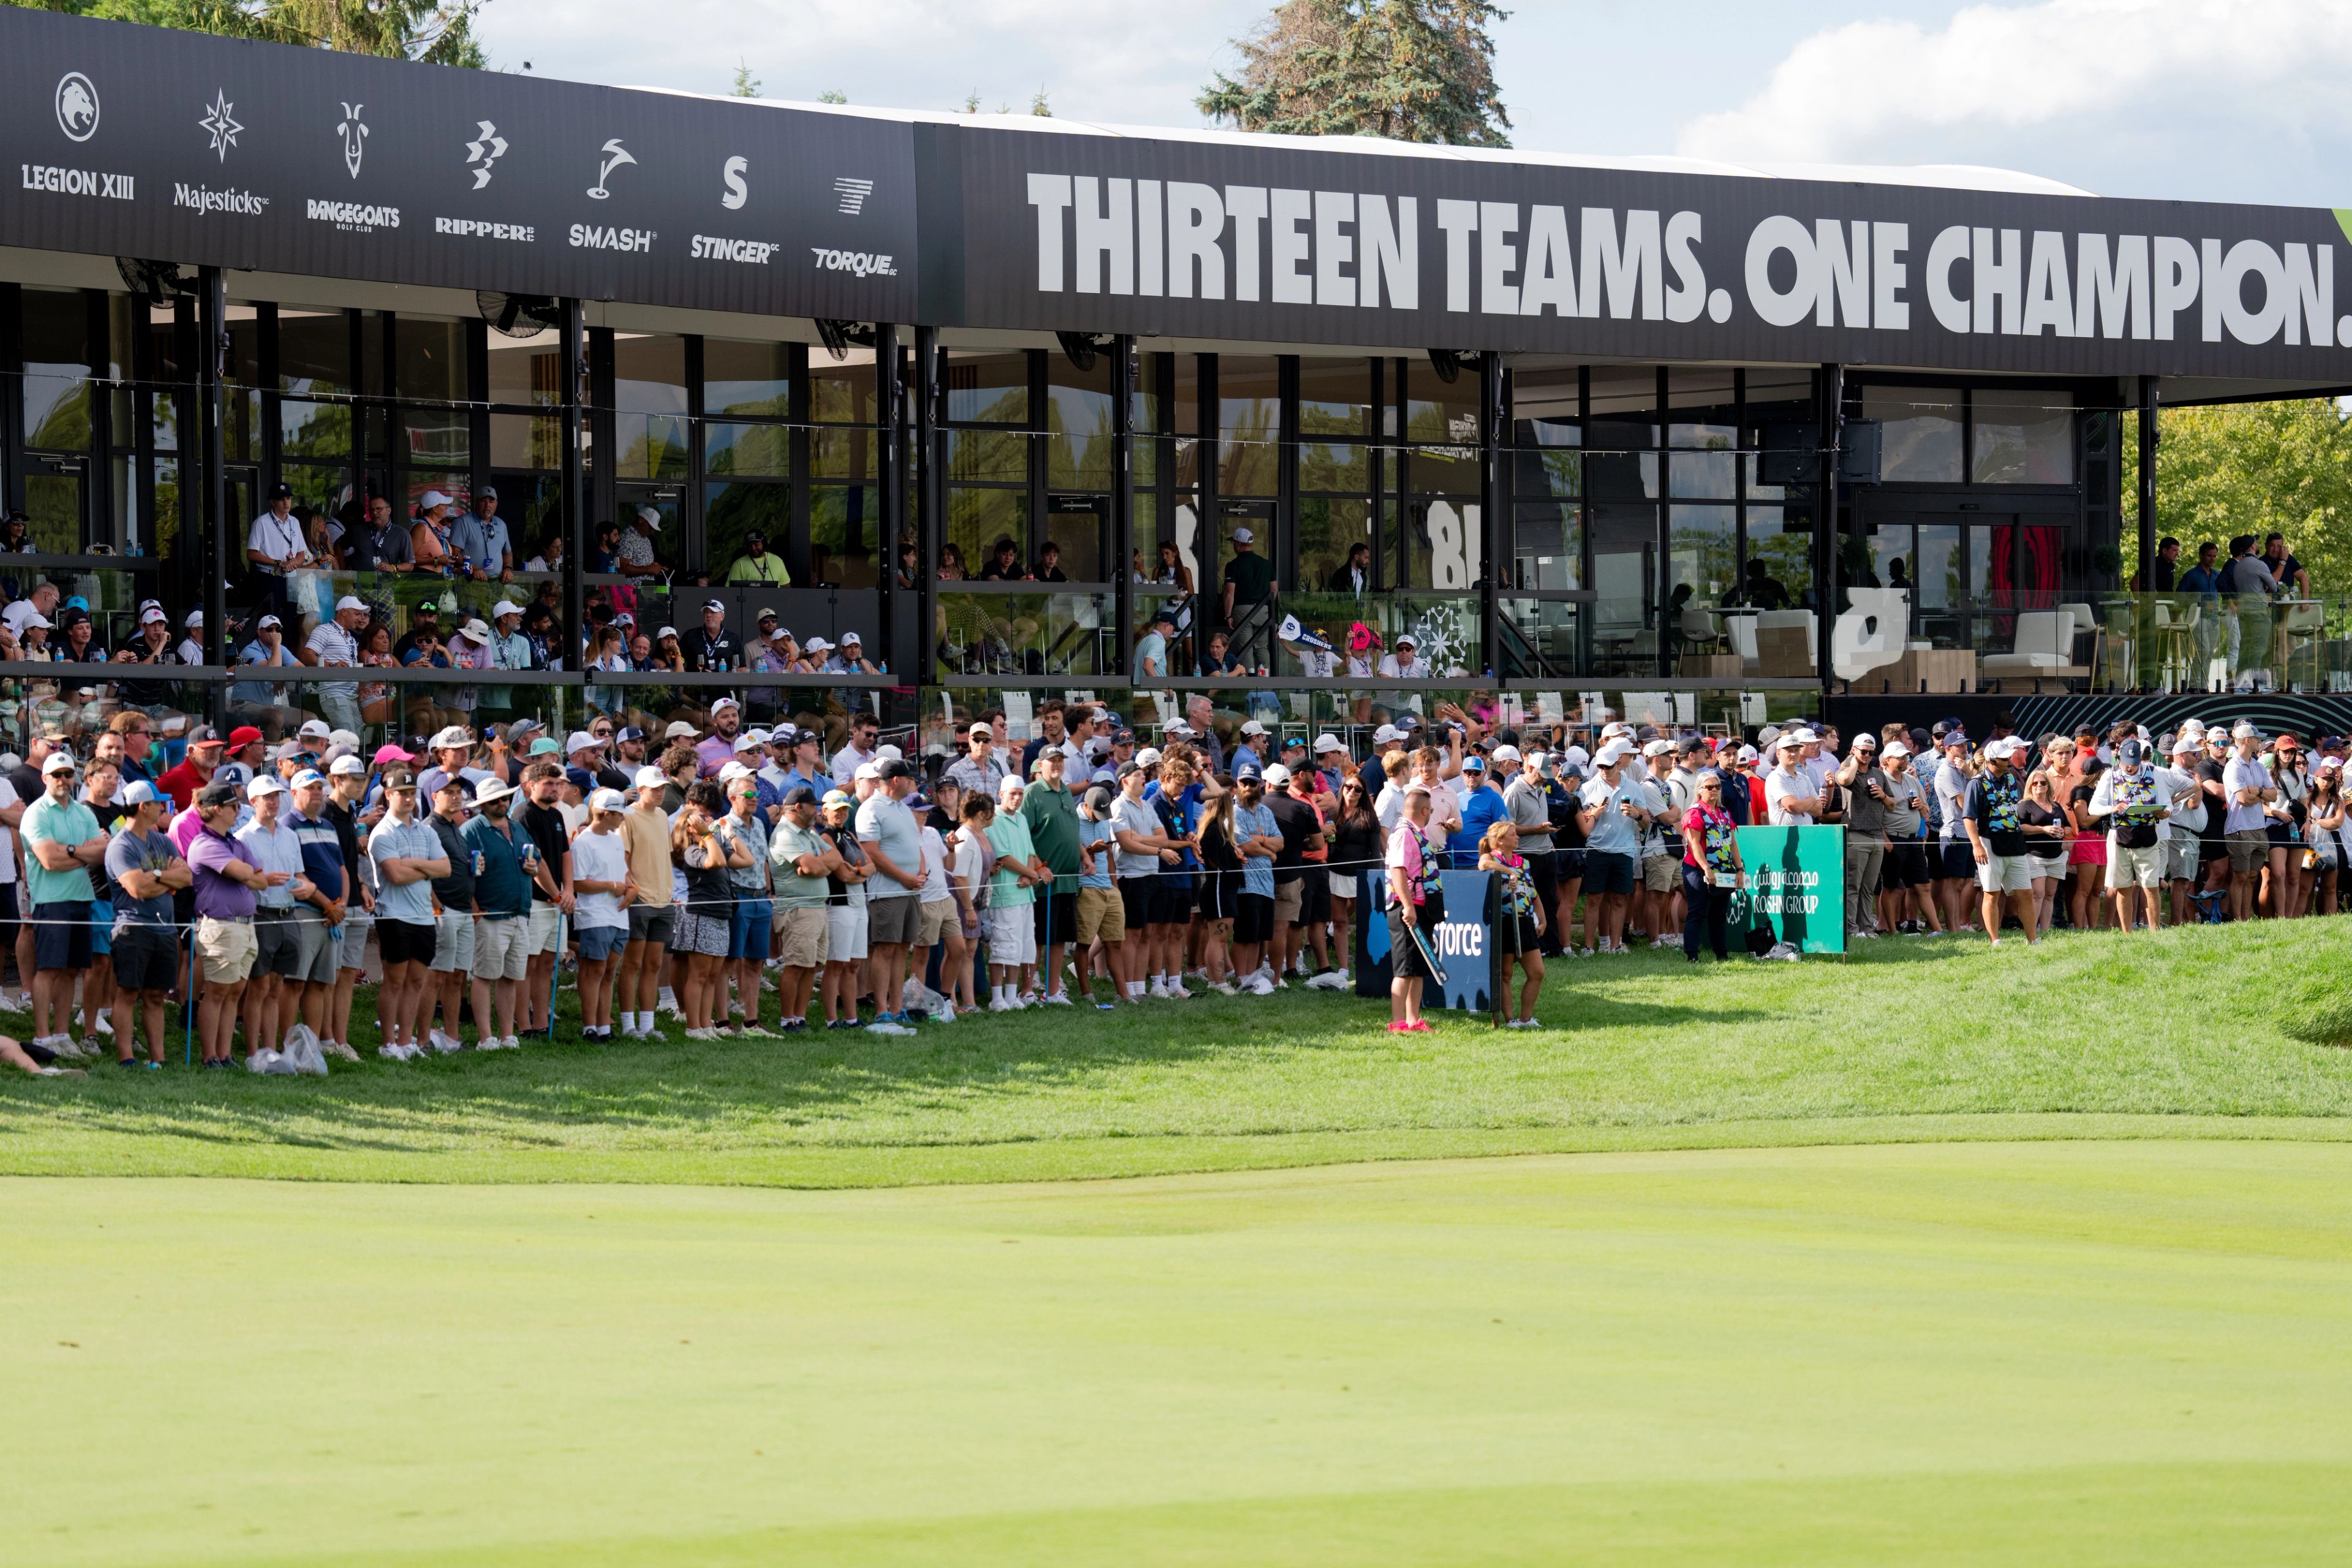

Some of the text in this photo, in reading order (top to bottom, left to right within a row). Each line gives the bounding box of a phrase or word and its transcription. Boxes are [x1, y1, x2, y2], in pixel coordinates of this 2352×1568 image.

[21, 164, 134, 200] LEGION XIII
[173, 183, 262, 216] Majesticks
[307, 198, 400, 228] RANGEGOATS
[435, 217, 527, 241] RIPPER
[568, 224, 651, 252] SMASH
[690, 234, 771, 264] STINGER
[811, 247, 892, 277] TORQUE
[1027, 173, 2352, 348] THIRTEEN TEAMS. ONE CHAMPION.
[1302, 633, 1332, 650] CRUSHERS
[1753, 864, 1819, 891] مجموعة روشن
[1753, 895, 1819, 914] ROSHN GROUP
